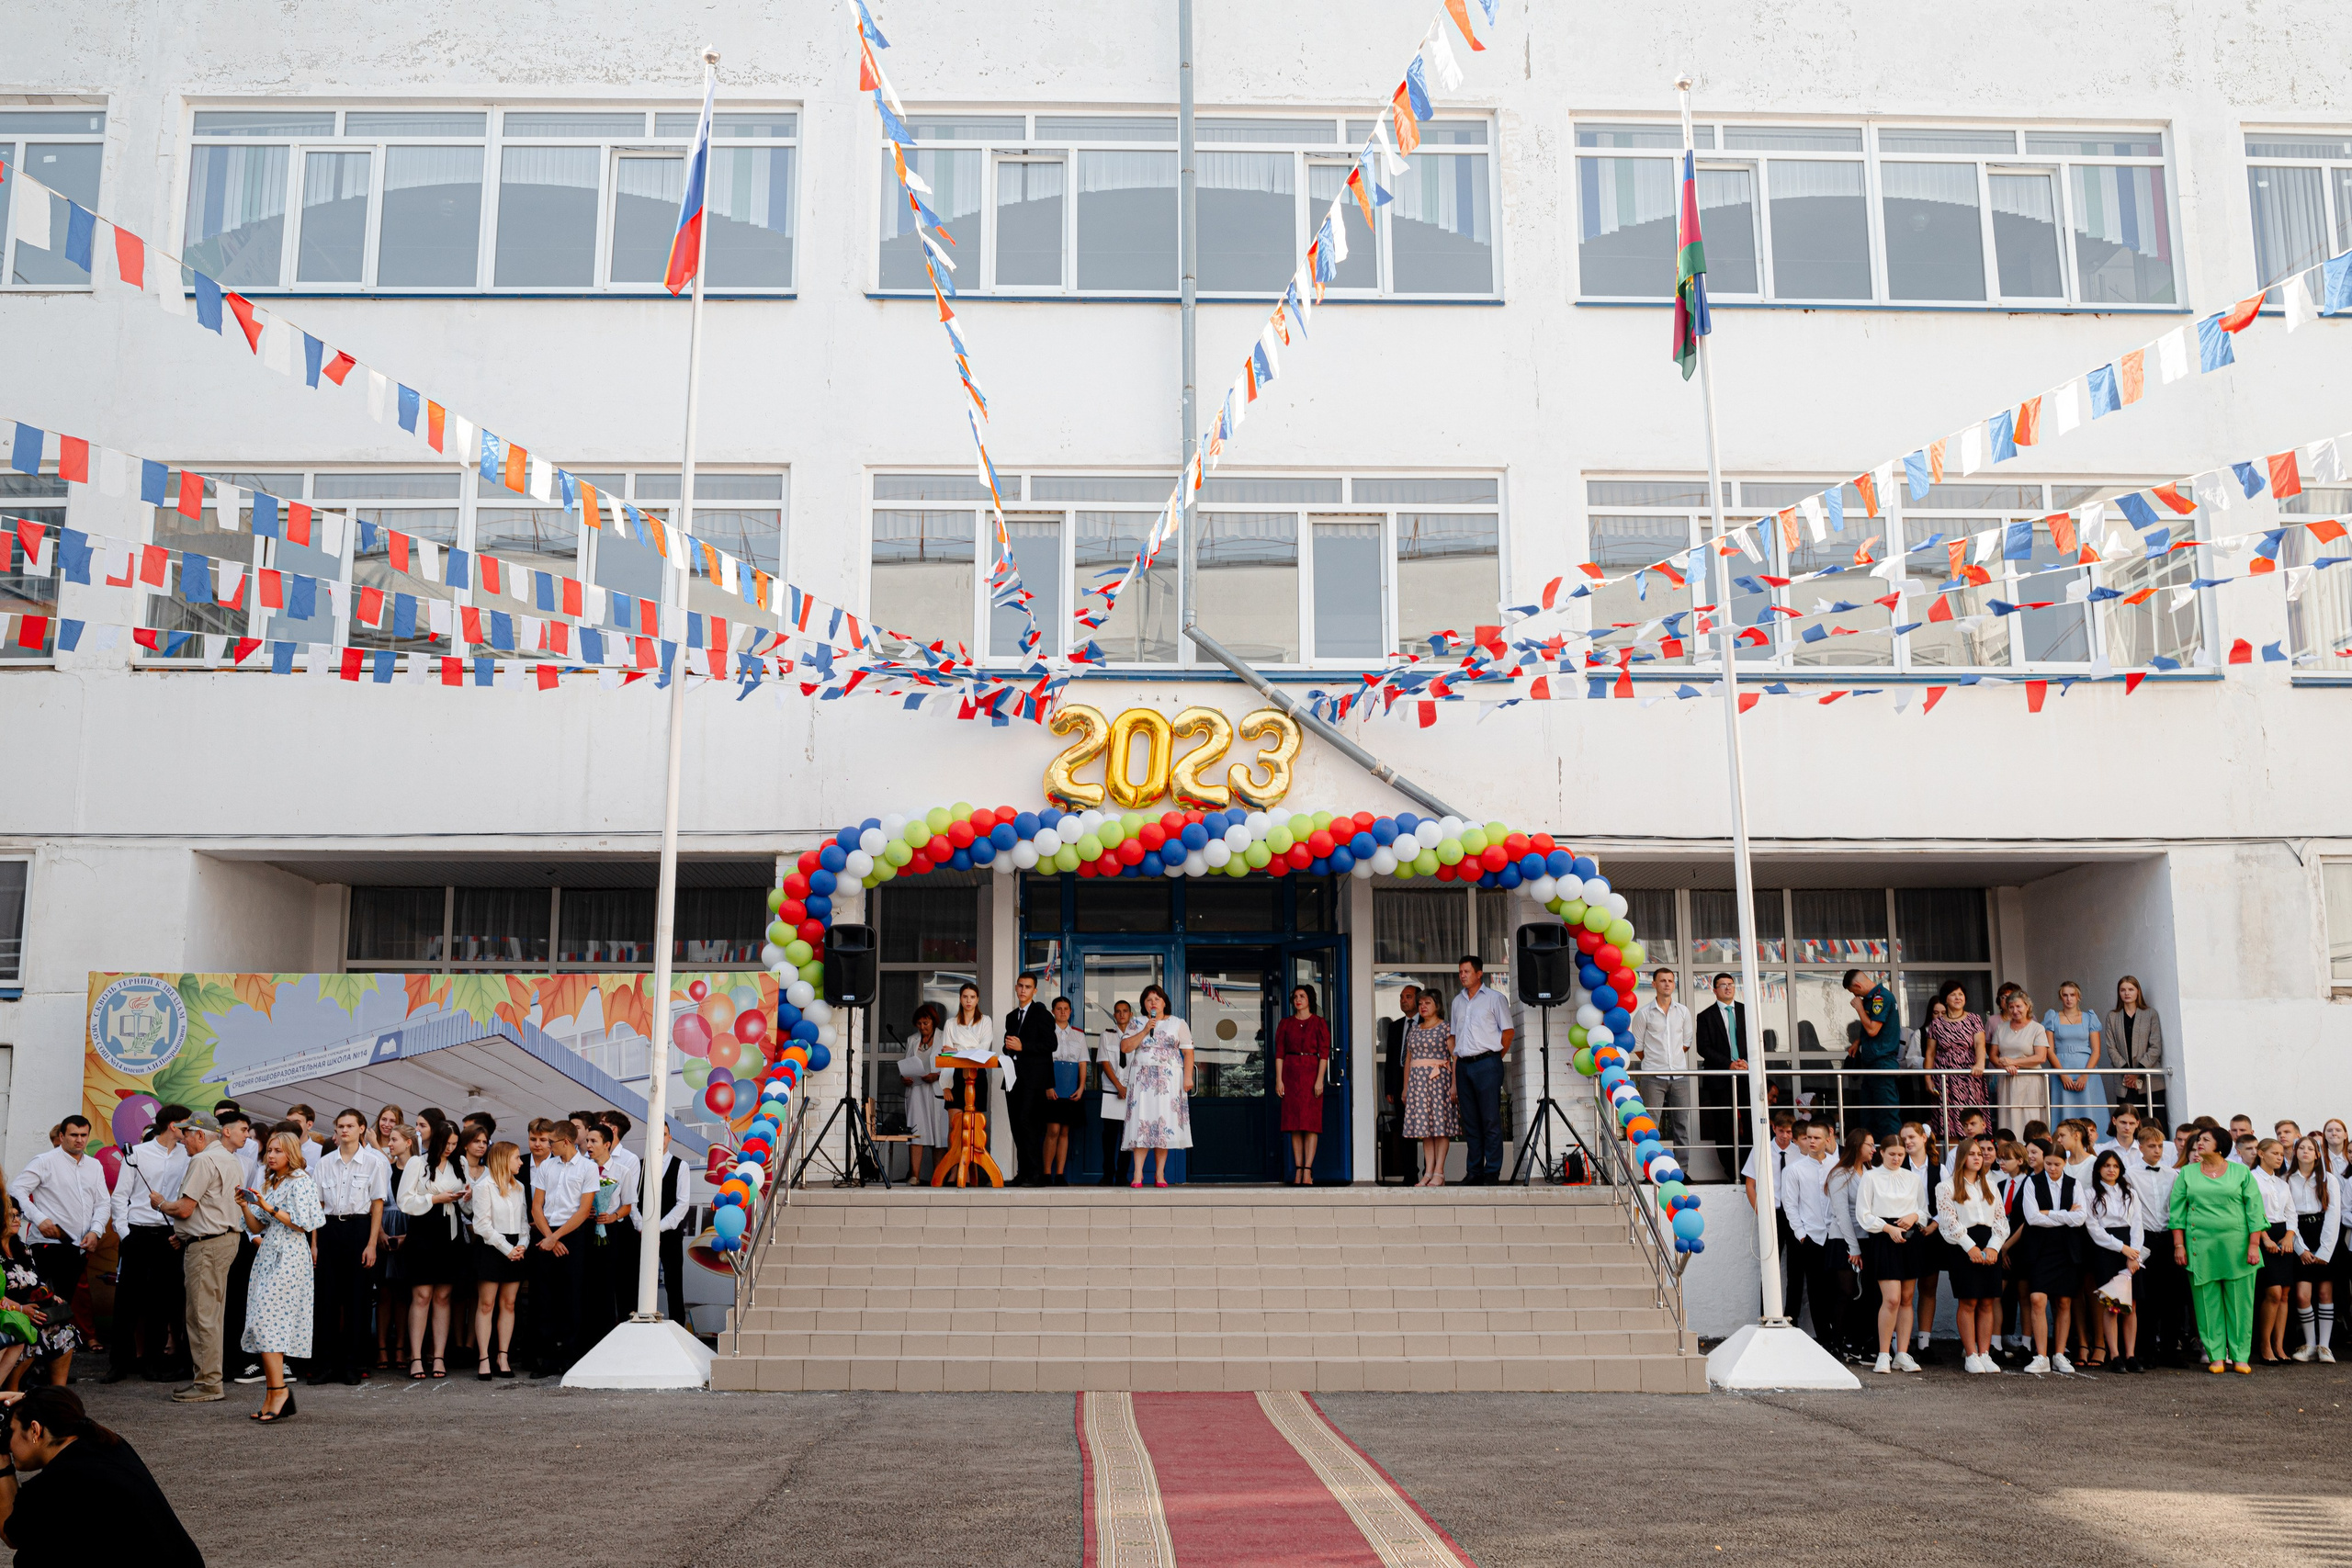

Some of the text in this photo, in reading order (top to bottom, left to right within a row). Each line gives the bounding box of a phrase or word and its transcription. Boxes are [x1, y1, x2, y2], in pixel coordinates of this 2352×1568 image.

[1043, 704, 1304, 813] 2023
[93, 987, 117, 1018] СКВОЗЬ
[117, 977, 153, 988] ТЕРНИИ
[162, 985, 186, 1020] ЗВЕЗДАМ
[91, 1023, 100, 1042] МОУ
[96, 1041, 110, 1060] СОШ
[107, 1057, 122, 1069] №14
[232, 1049, 368, 1089] СРЕДНЯЯ ОБЩЕОБРАЗОВАТЕЛЬНАЯ ШКОЛА №14
